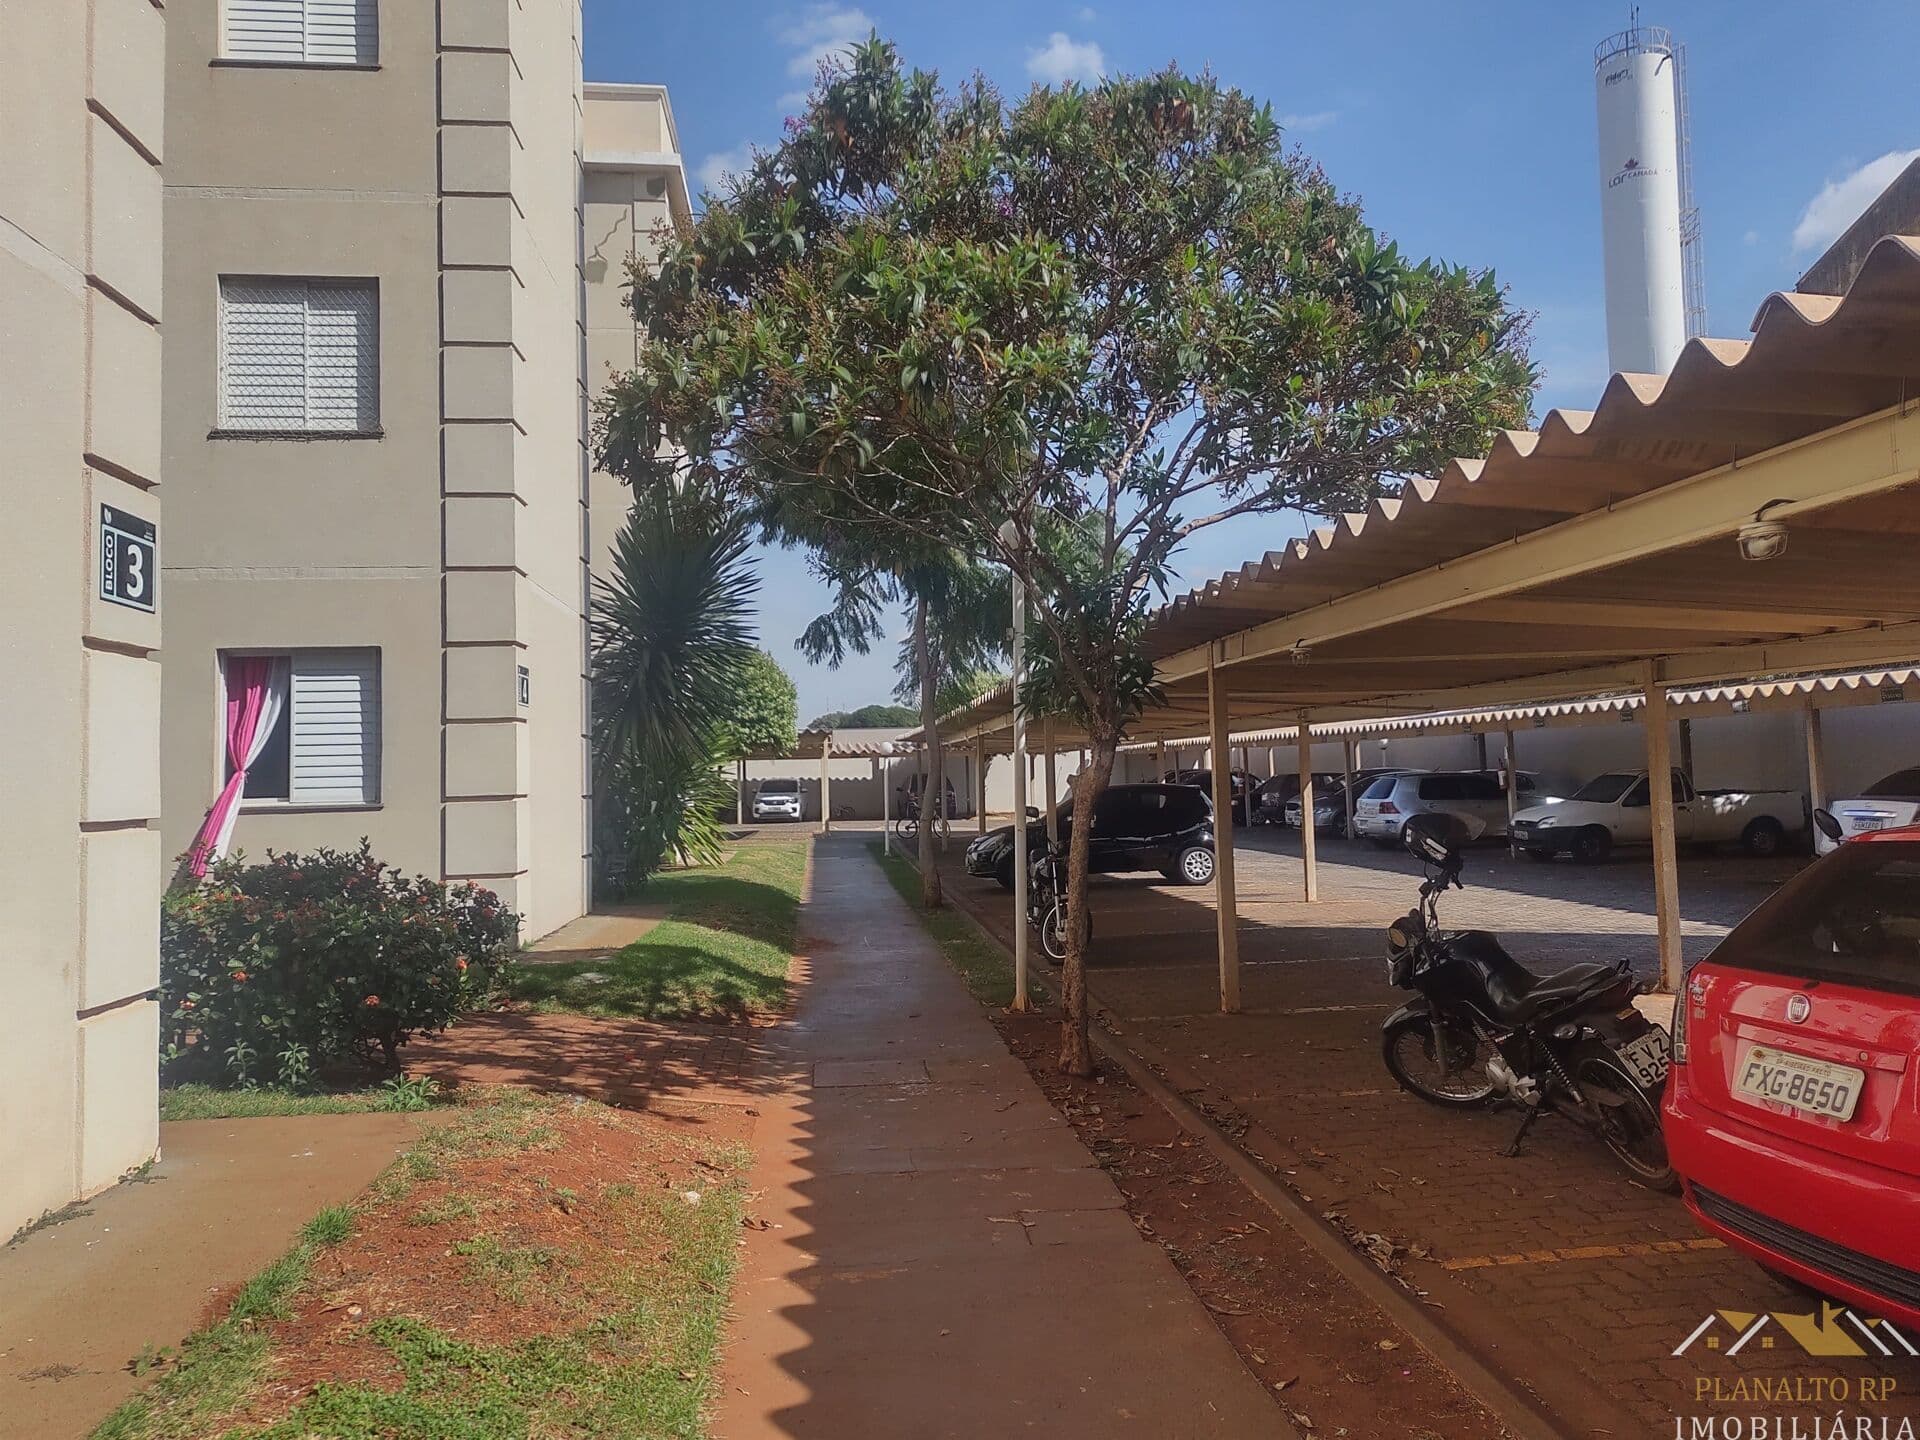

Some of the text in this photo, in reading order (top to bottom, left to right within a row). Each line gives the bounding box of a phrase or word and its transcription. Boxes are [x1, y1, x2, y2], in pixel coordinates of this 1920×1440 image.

[105, 535, 113, 590] BLOCO
[126, 544, 144, 598] 3
[1629, 1037, 1670, 1069] FVZ
